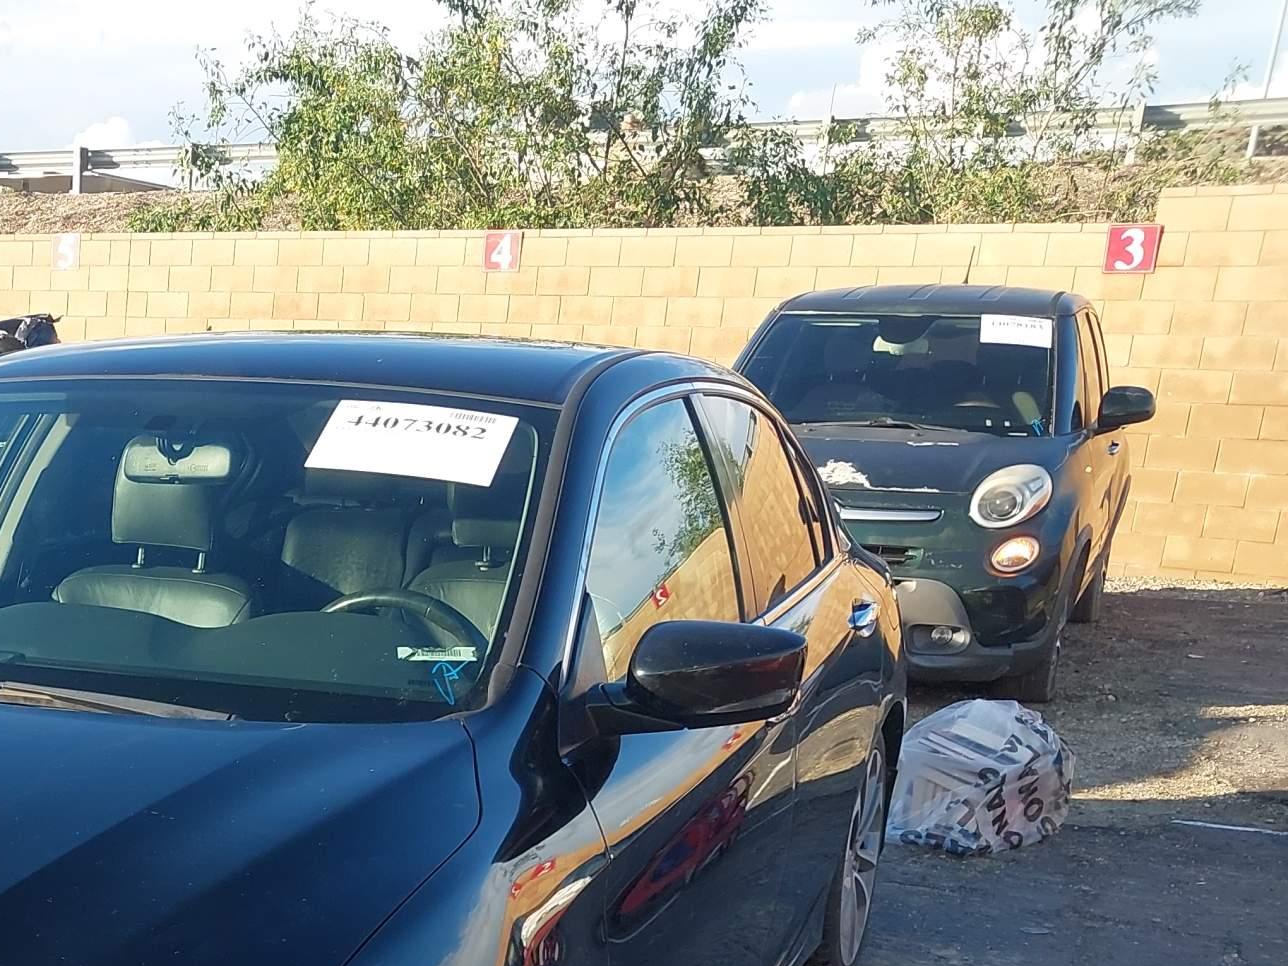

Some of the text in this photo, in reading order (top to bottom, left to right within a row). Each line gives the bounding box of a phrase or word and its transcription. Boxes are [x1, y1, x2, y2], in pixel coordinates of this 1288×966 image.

[490, 232, 513, 270] 4
[1113, 227, 1146, 271] 3
[347, 414, 488, 440] 44073082
